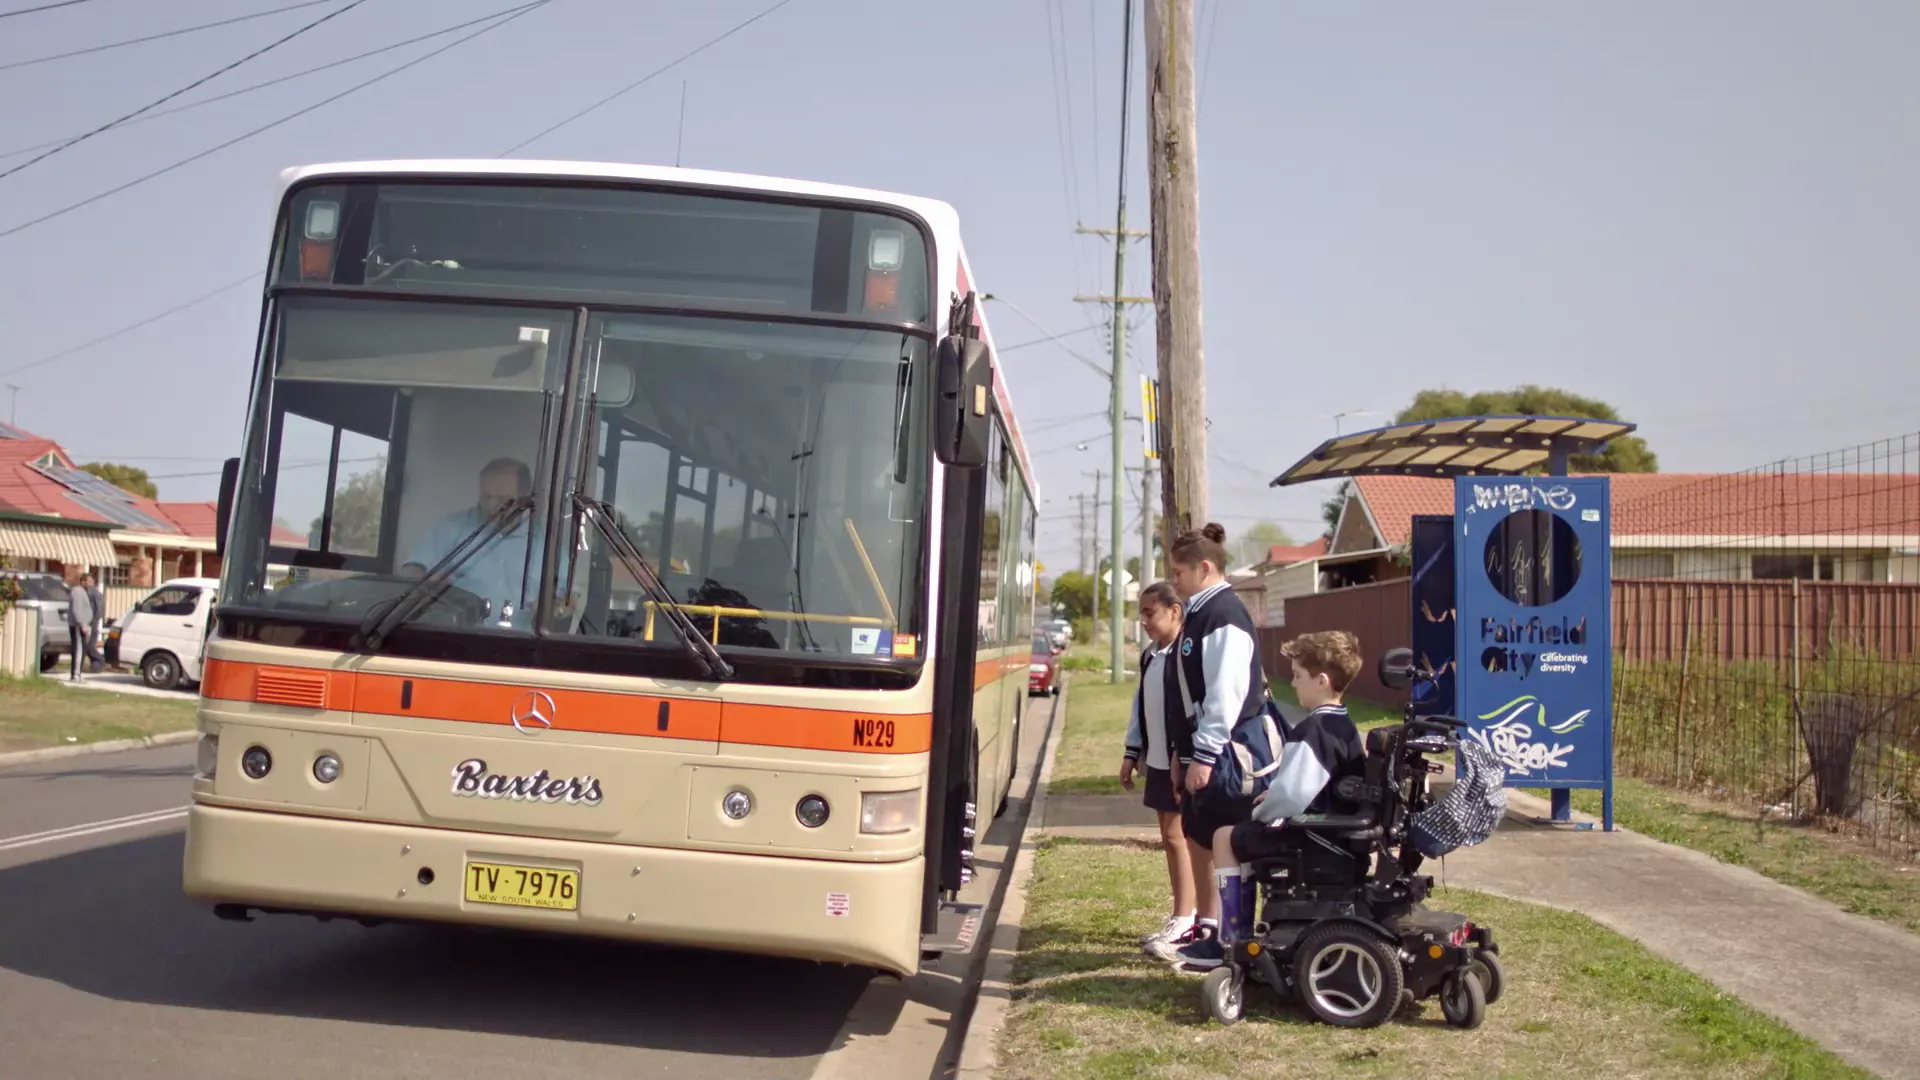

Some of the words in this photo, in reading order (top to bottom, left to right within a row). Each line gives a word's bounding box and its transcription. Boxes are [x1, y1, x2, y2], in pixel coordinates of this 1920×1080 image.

[1481, 615, 1587, 645] Fairfield
[1481, 646, 1536, 680] City
[1540, 652, 1588, 664] Celebrating
[1540, 663, 1576, 673] diversity
[451, 758, 603, 806] Baxter's
[479, 894, 498, 902] NEW
[502, 896, 531, 905] SOUTH
[536, 899, 564, 908] WALES
